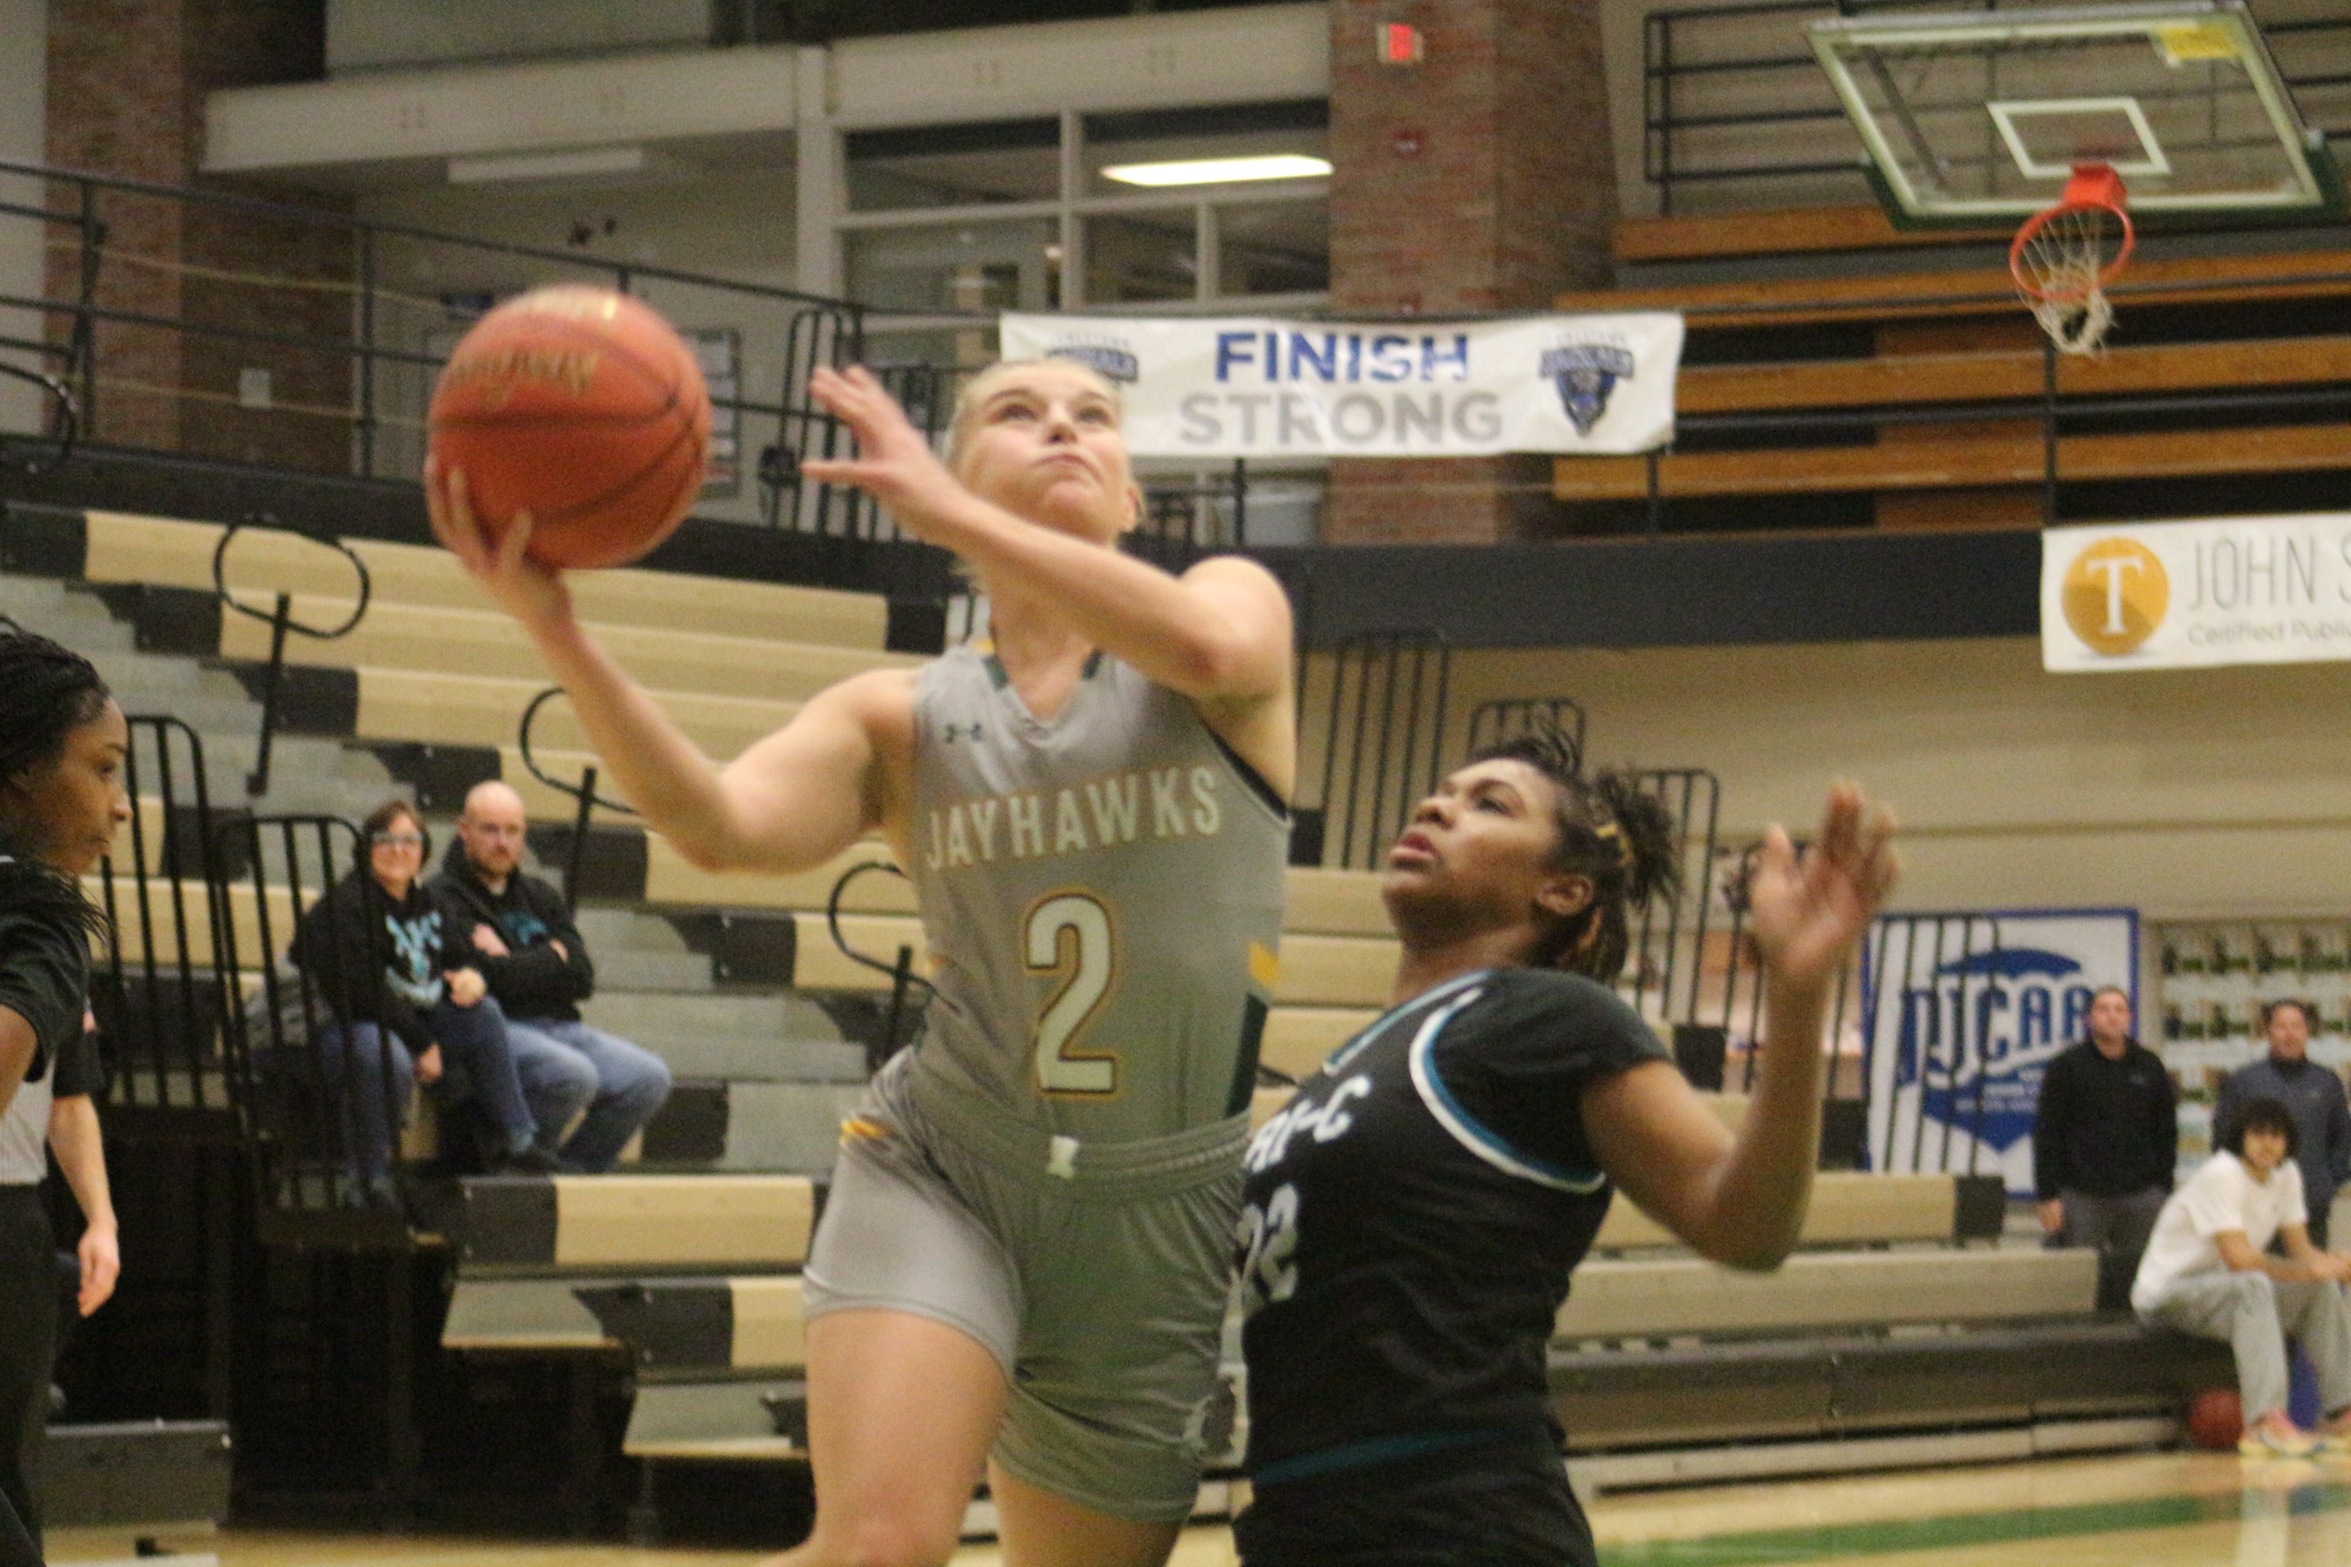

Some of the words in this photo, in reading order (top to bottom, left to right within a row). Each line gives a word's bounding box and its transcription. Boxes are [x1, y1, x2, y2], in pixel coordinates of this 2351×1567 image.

[1215, 332, 1467, 383] FINISH
[1181, 392, 1501, 445] STRONG
[2087, 555, 2144, 635] T
[2188, 535, 2315, 610] JOHN
[926, 765, 1221, 872] JAYHAWKS
[1024, 890, 1117, 1096] 2
